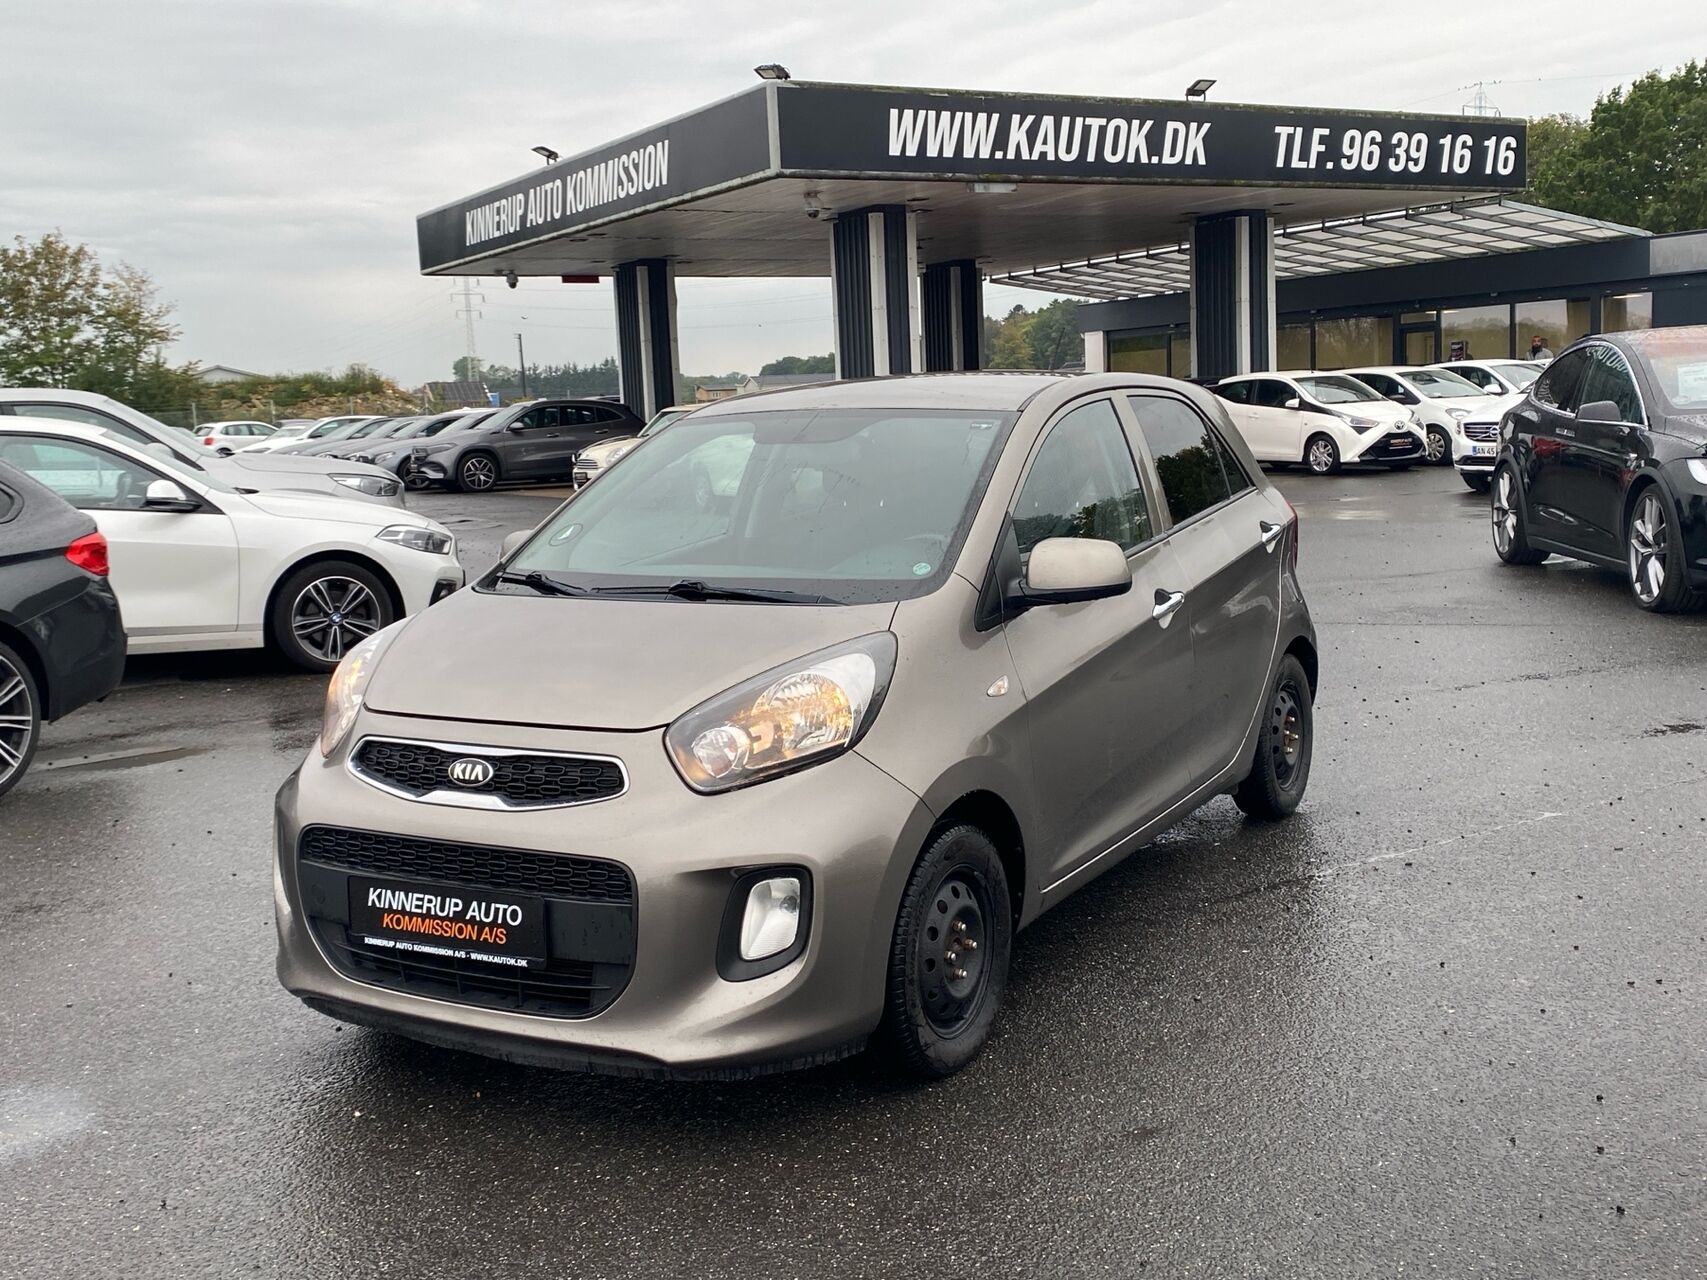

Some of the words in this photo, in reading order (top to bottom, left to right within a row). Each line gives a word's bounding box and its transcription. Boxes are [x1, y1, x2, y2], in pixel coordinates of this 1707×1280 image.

[889, 108, 1211, 165] WWW.KAUTOK.DK
[1274, 126, 1333, 170] TLF.
[1341, 129, 1382, 171] 96
[1388, 132, 1428, 173] 39
[1439, 134, 1473, 174] 16
[1484, 136, 1517, 176] 16
[465, 193, 524, 246] KINNERUP
[526, 179, 562, 227] AUTO
[566, 140, 669, 215] KOMMISSION
[453, 763, 483, 781] KIA
[367, 887, 463, 917] KINNERUP
[465, 900, 523, 926] AUTO
[382, 913, 477, 941] KOMMISSION
[480, 926, 507, 944] A/S
[364, 937, 395, 947] KINNERUP
[395, 942, 412, 950] AUTO
[413, 944, 453, 956] KOMMISSION
[454, 949, 466, 958] A/S
[470, 952, 528, 967] WWW.KAUTOK.DK
